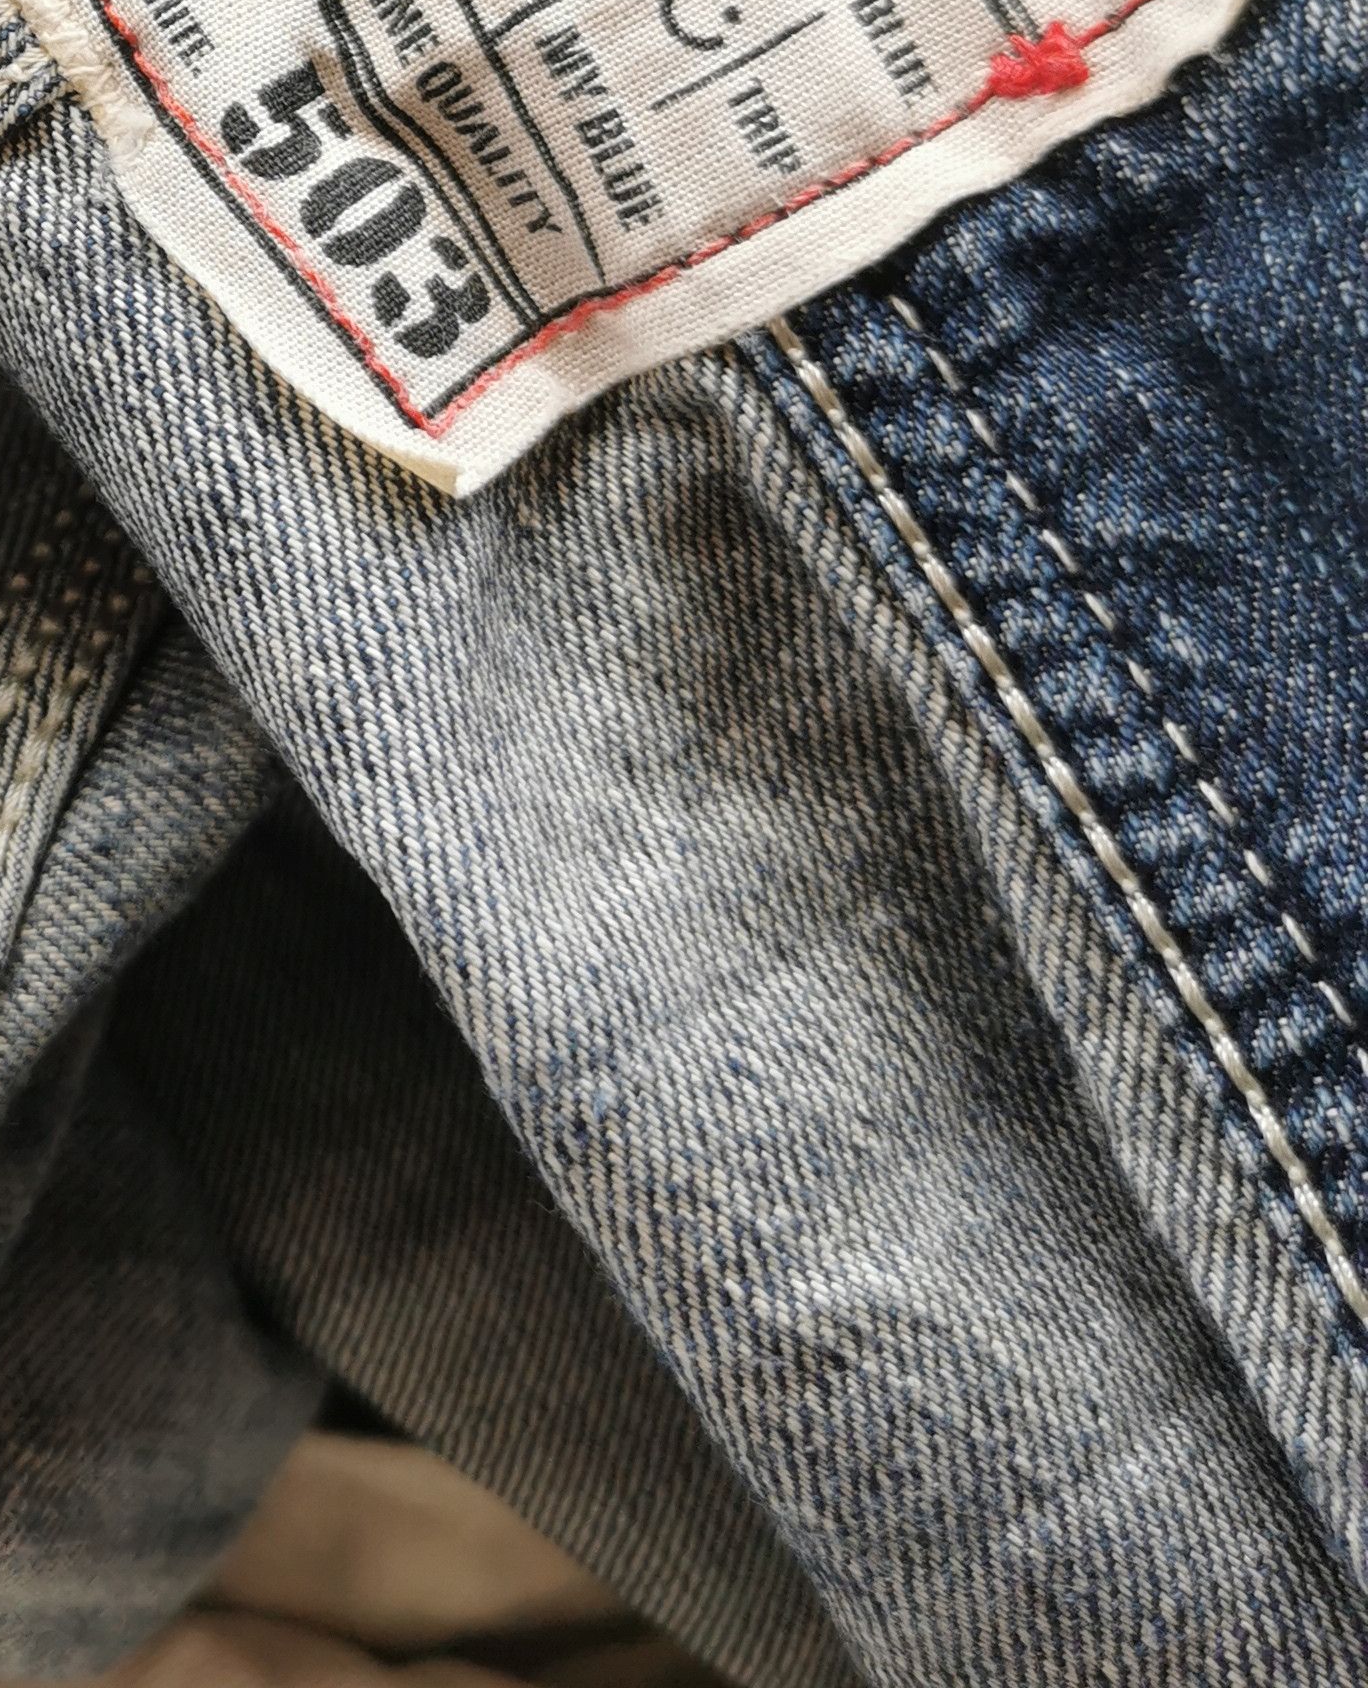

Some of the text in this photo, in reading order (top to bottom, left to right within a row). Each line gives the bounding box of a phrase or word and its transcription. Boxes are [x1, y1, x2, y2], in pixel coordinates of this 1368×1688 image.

[220, 58, 492, 360] 503
[415, 60, 563, 237] QUALITY
[535, 24, 663, 233] MY BLUE
[727, 77, 803, 176] TRIP
